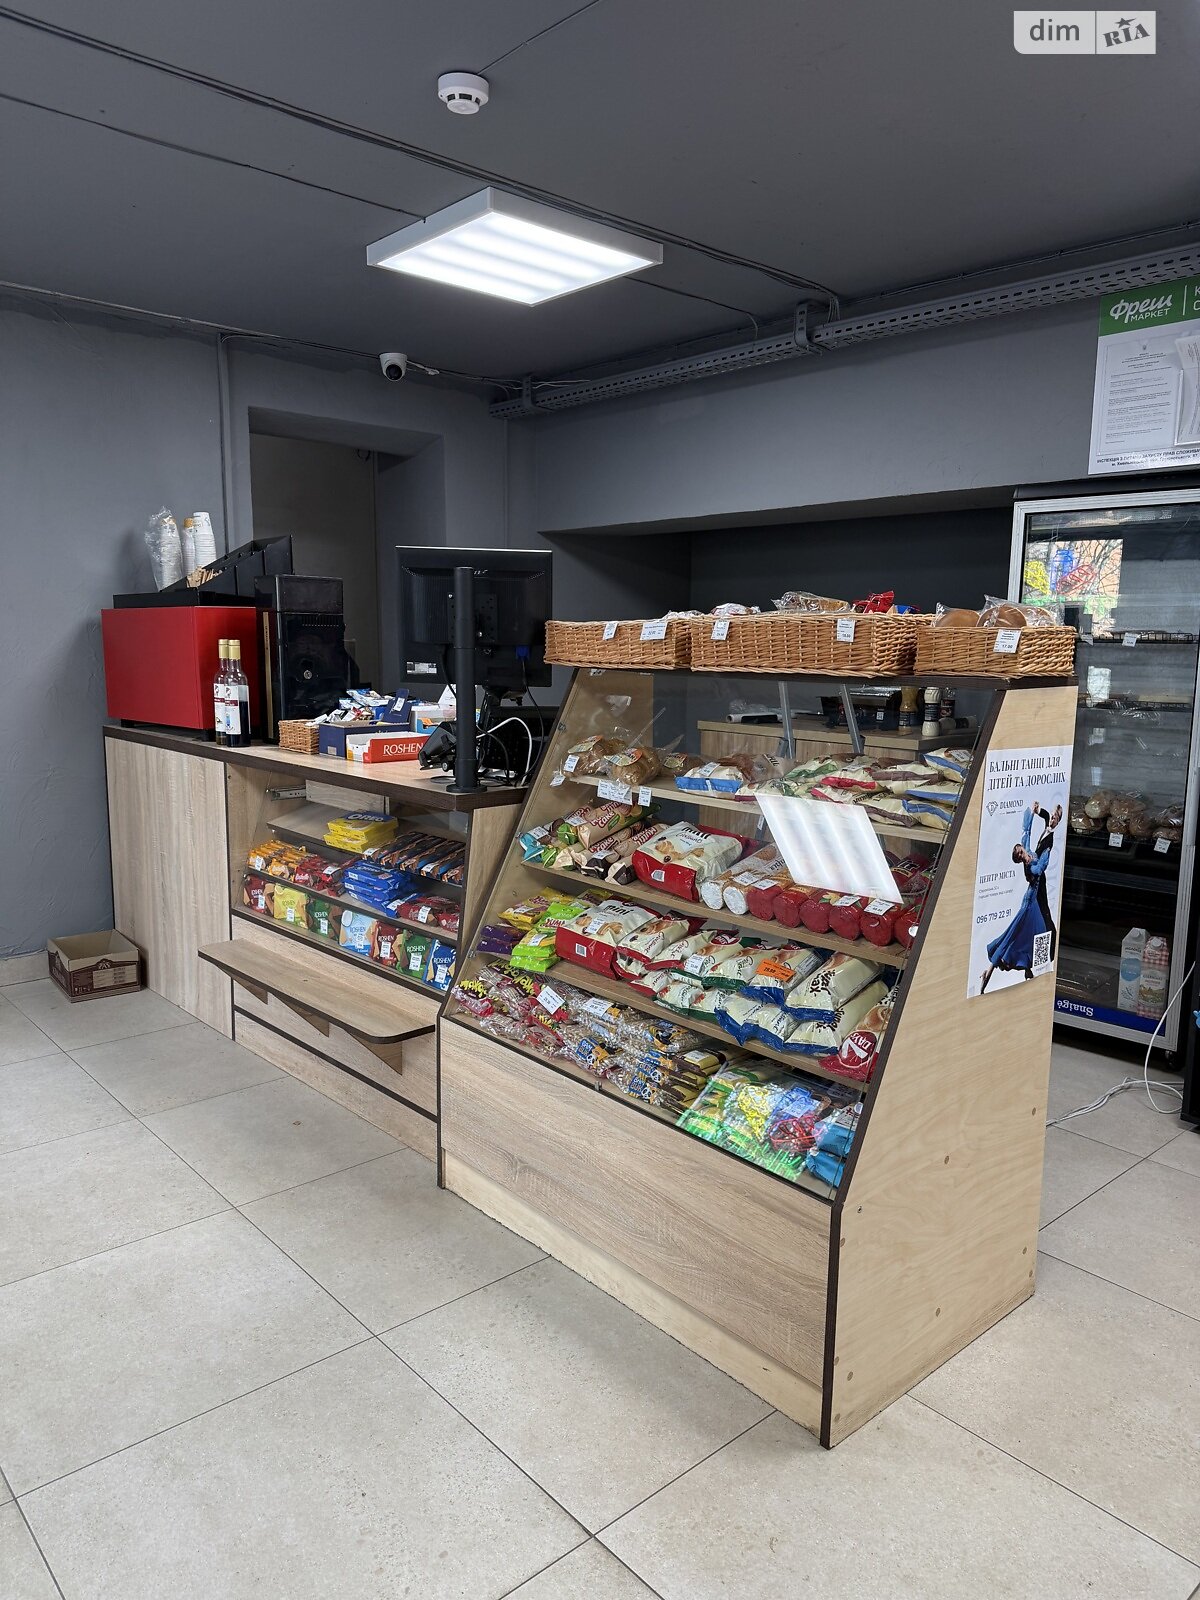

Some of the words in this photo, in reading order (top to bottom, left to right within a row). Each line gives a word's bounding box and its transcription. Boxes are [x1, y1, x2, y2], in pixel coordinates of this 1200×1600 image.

[1110, 294, 1173, 324] Фреш
[1130, 307, 1171, 322] МАРКЕТ
[383, 743, 424, 756] ROSHEN
[989, 759, 1019, 773] БАЛЬНІ
[1021, 757, 1045, 770] ТАНЦІ
[1045, 756, 1061, 769] ДЛЯ
[987, 774, 1013, 791] ДІТЕЙ
[1014, 776, 1024, 788] ТА
[1025, 772, 1066, 788] ДОРОСЛИХ
[999, 799, 1024, 810] DIAMOND
[979, 873, 999, 884] ЦЕНТР
[998, 870, 1016, 881] МІСТА
[603, 904, 635, 916] mini
[976, 914, 988, 924] 096
[988, 912, 998, 921] 779
[998, 910, 1005, 919] 22
[433, 957, 452, 965] ROSHEN
[1057, 1000, 1094, 1017] Snaigė
[850, 1031, 874, 1050] DAYS
